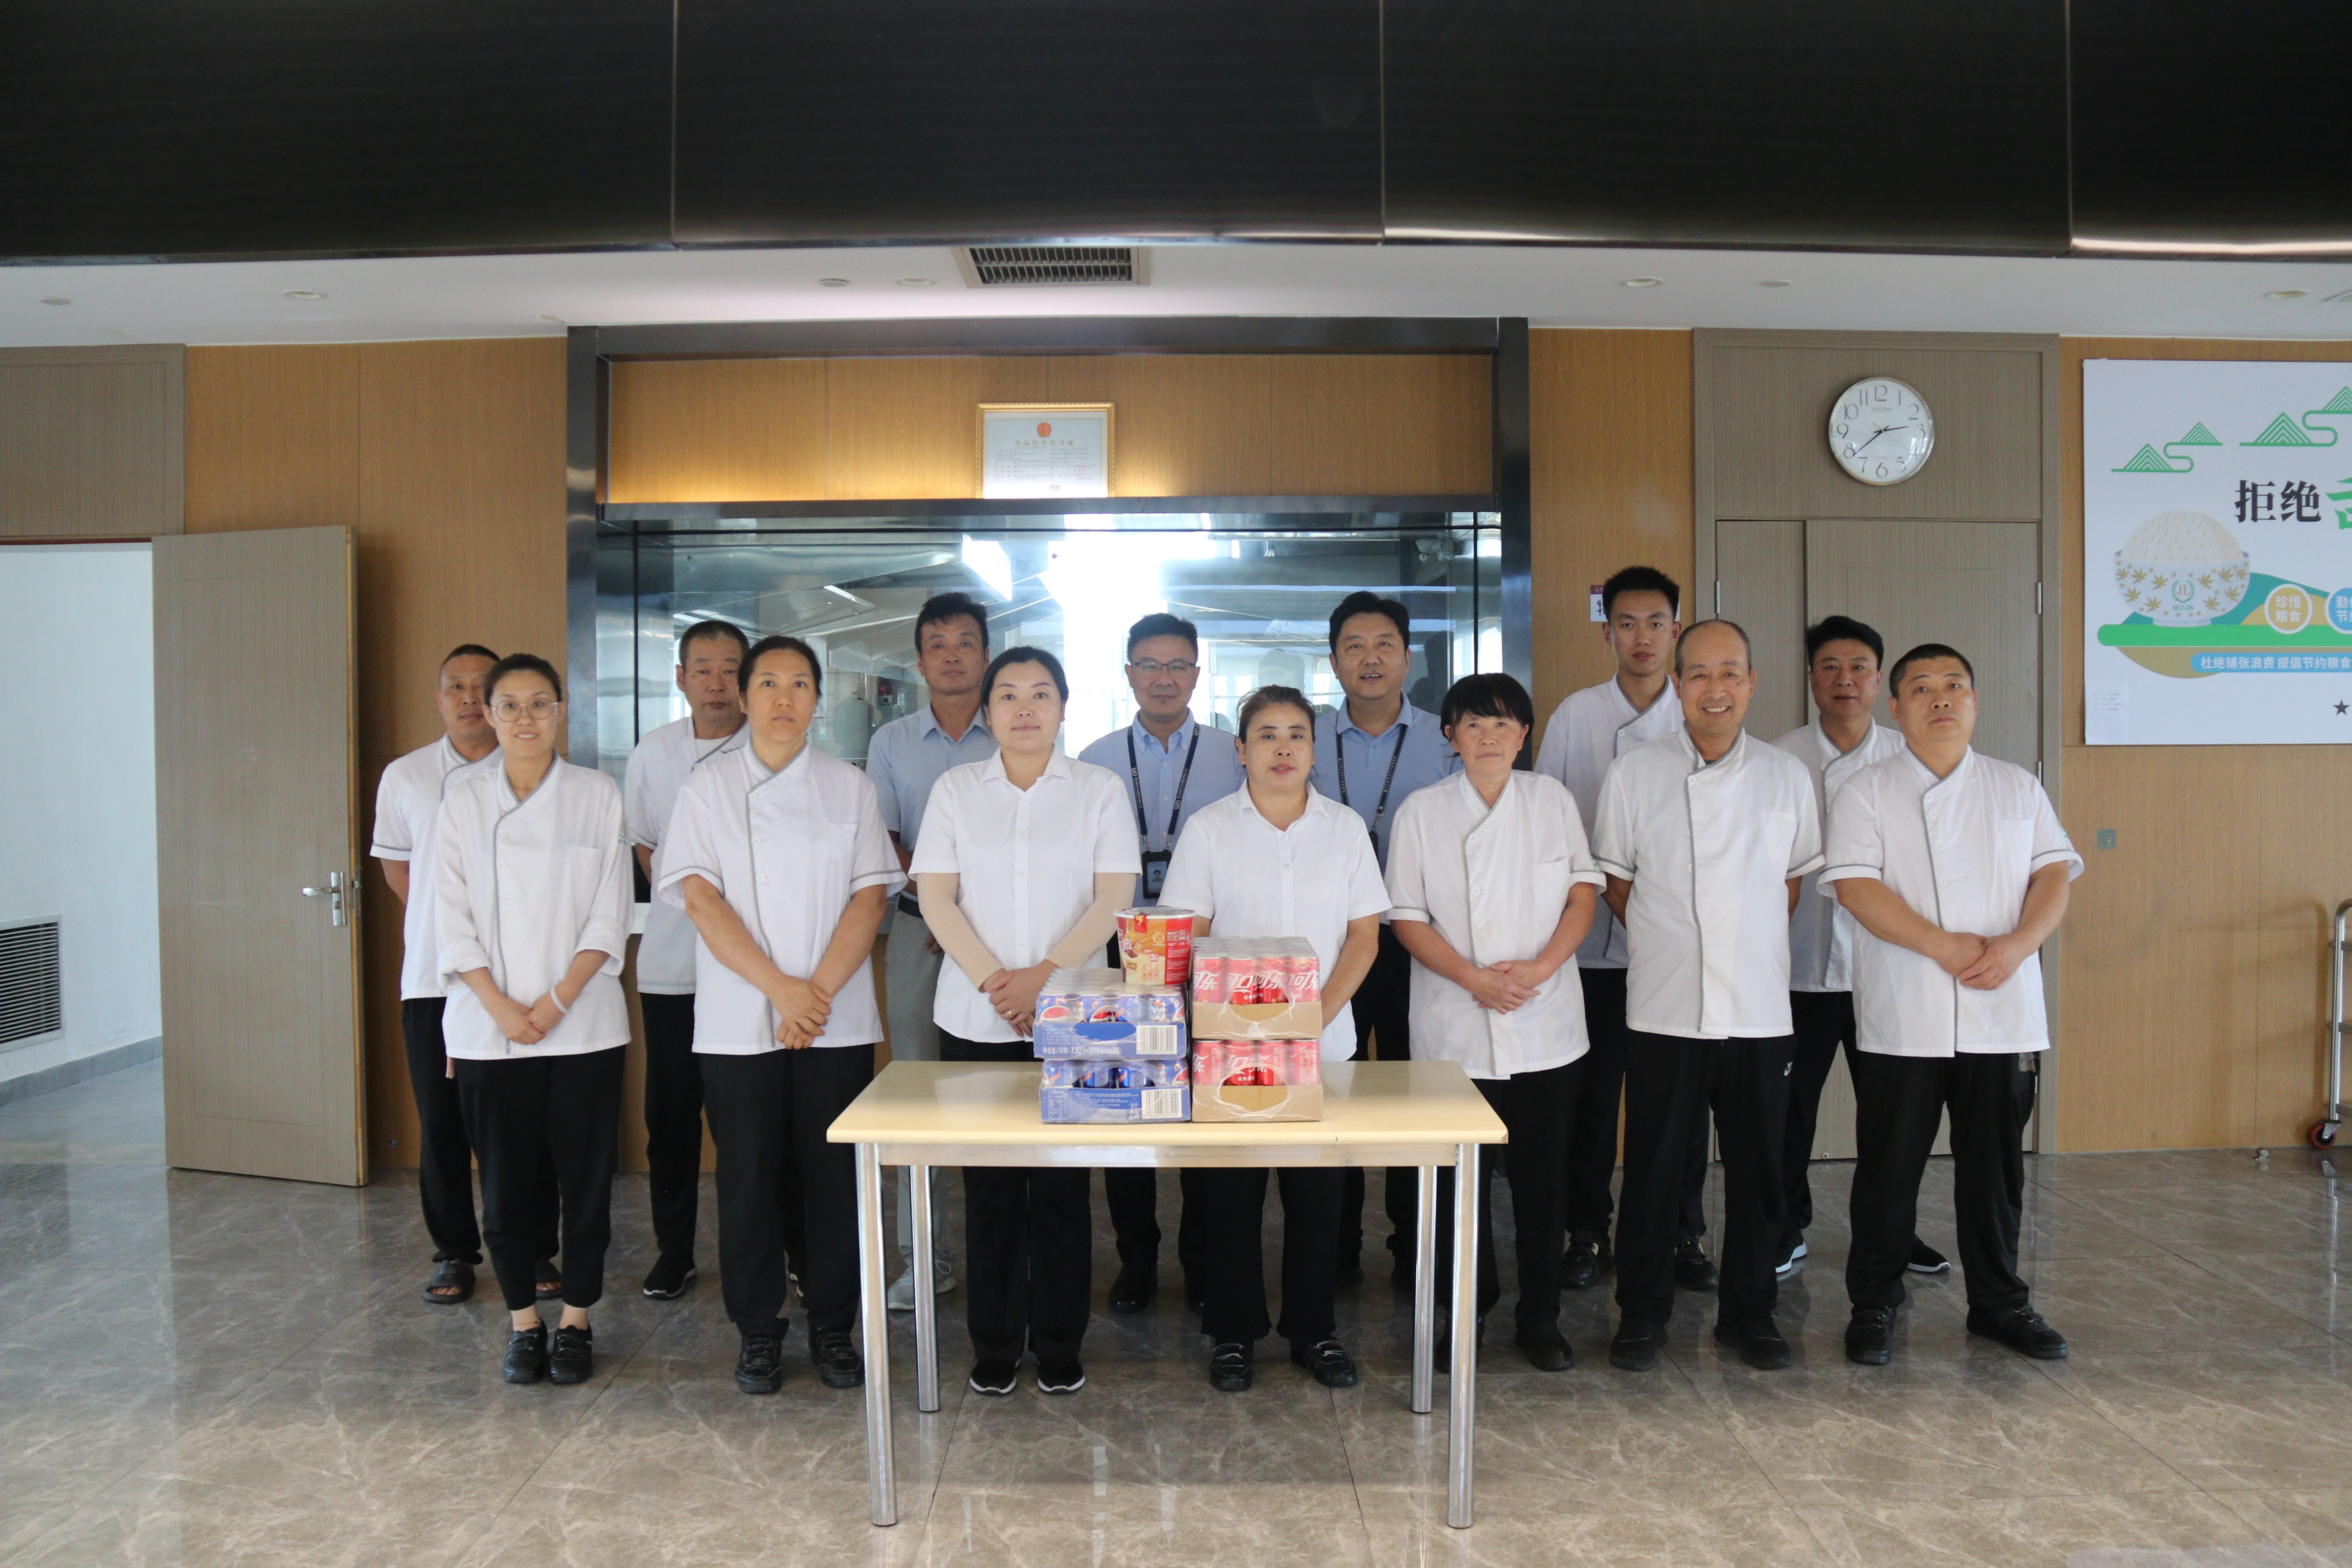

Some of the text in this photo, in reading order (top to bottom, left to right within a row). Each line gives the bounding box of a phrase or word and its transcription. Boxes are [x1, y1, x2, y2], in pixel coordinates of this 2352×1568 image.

[1860, 390, 1867, 405] 11
[1875, 385, 1887, 401] 12
[1844, 404, 1858, 419] 10
[1909, 404, 1919, 420] 2
[1837, 423, 1849, 439] 9
[1916, 423, 1926, 439] 3
[1844, 443, 1855, 459] 8
[1858, 457, 1867, 473] 7
[1876, 462, 1888, 478] 6
[1895, 457, 1906, 473] 5
[2176, 584, 2190, 595] JL
[2276, 595, 2301, 608] 珍惜
[2336, 595, 2352, 608] 勤
[2276, 611, 2301, 622] 粮食
[2201, 657, 2351, 669] 杜绝铺张浪费 提倡节约粮食
